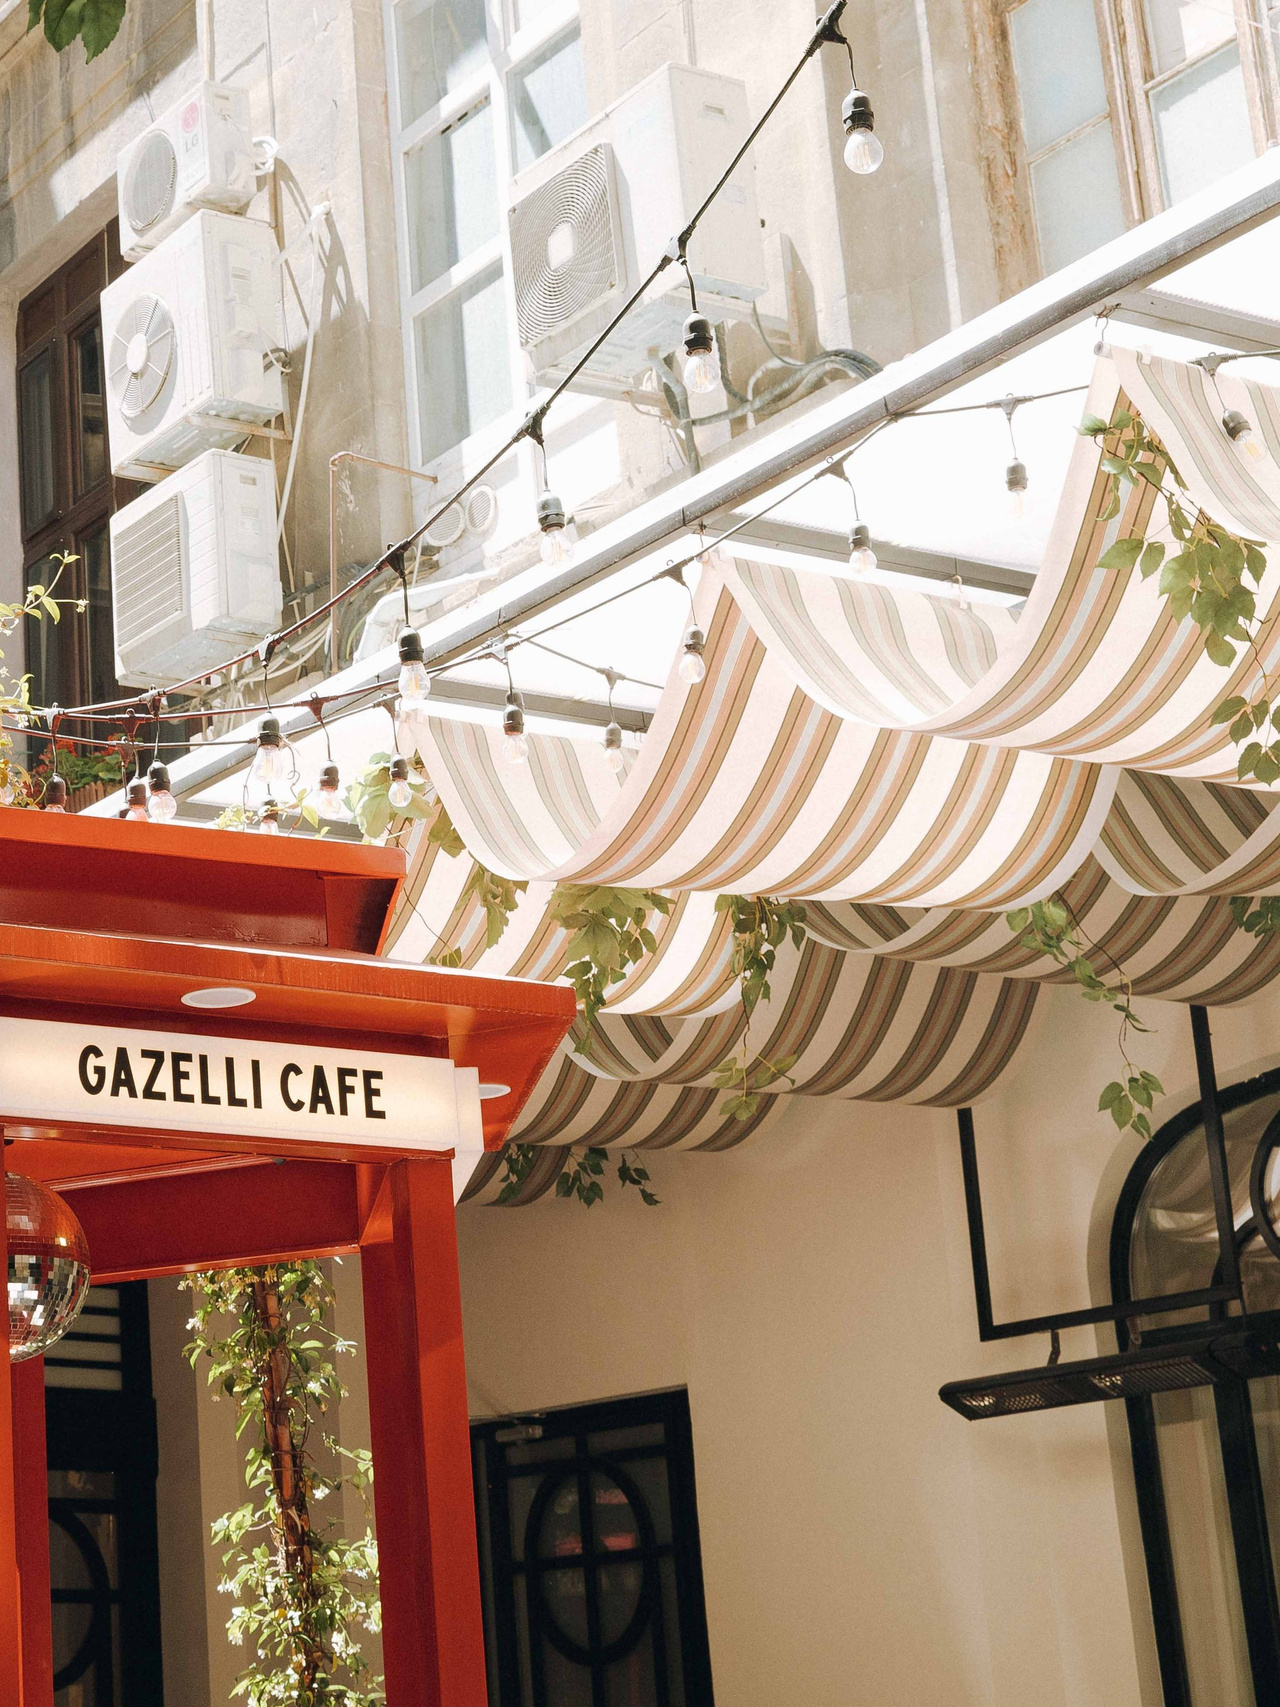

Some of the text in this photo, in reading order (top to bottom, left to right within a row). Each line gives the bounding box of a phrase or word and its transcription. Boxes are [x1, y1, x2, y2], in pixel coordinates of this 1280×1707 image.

[185, 133, 199, 153] LG
[78, 1044, 387, 1120] GAZELLI CAFE
